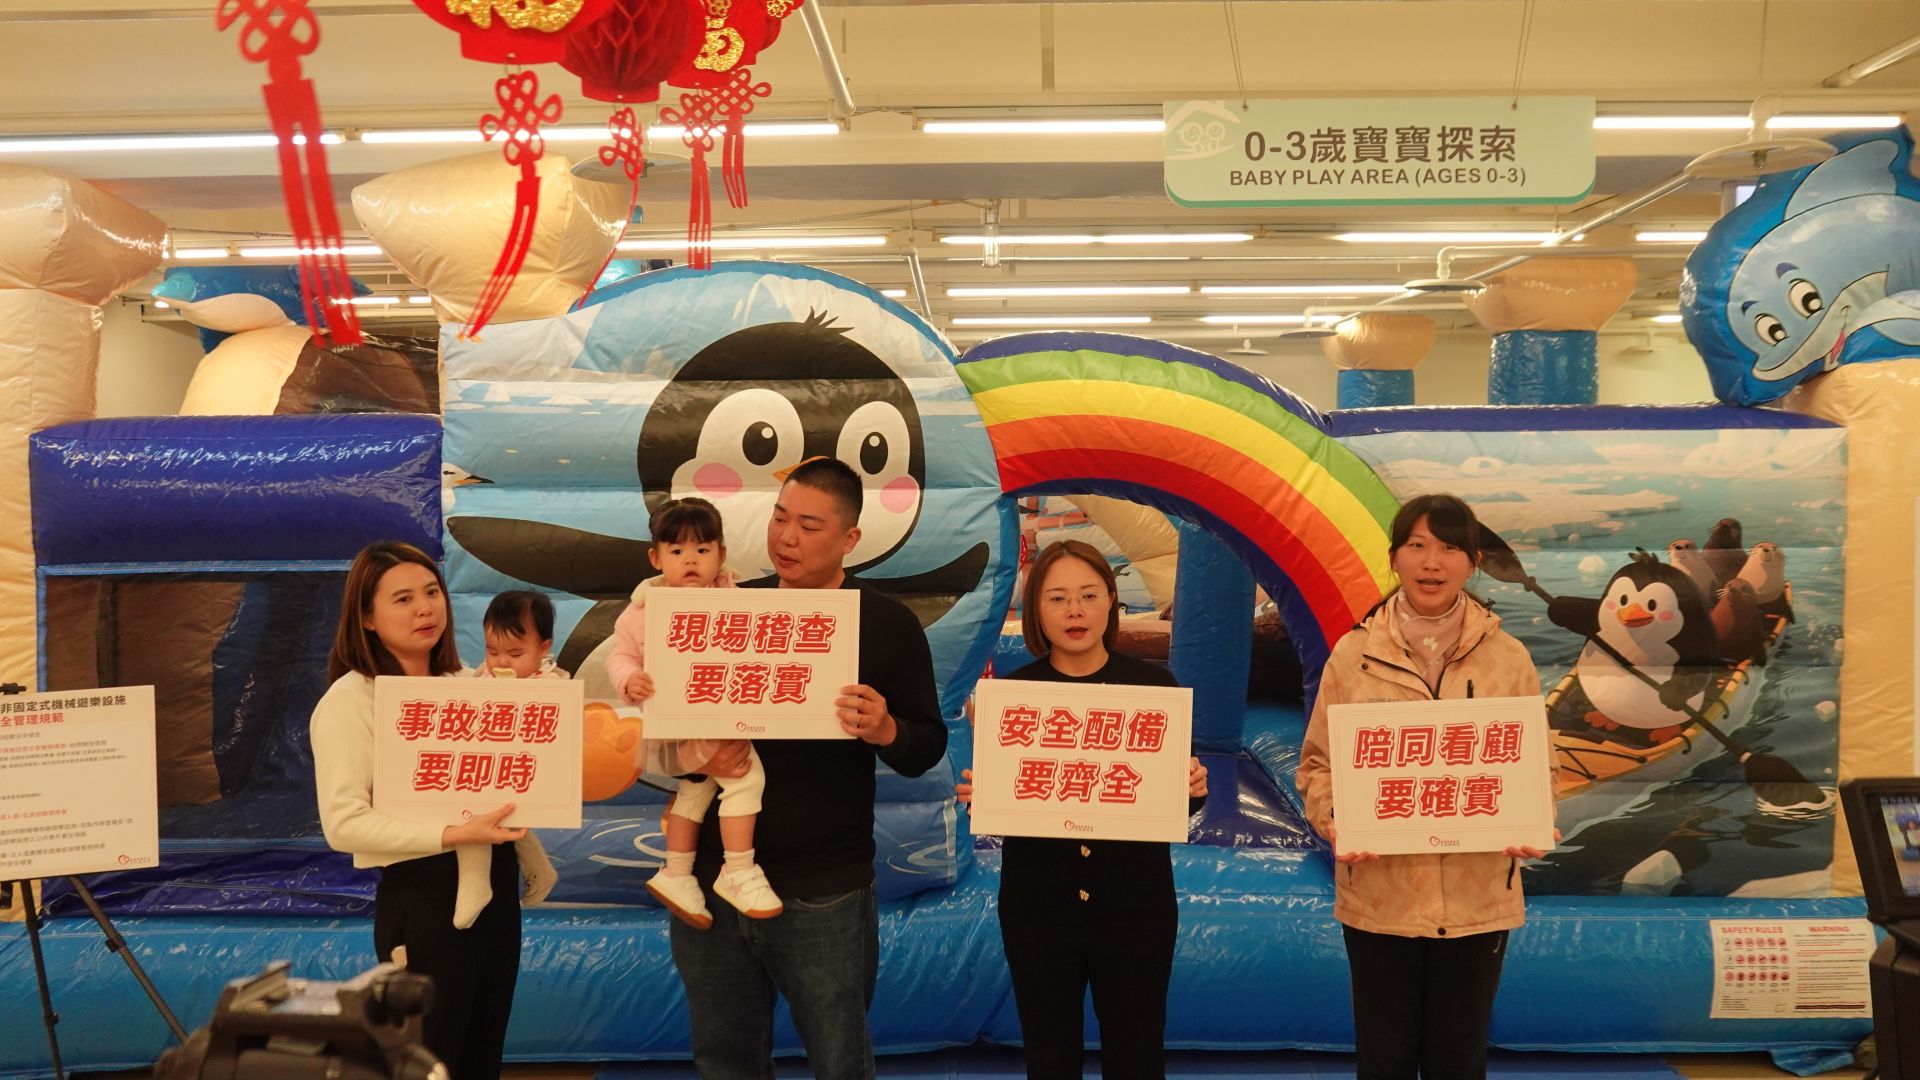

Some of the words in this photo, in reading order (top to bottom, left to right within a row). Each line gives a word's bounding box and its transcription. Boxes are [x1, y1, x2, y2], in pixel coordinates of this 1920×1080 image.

[1244, 125, 1517, 164] 0-3歲寶寶探索
[1229, 169, 1287, 187] BABY
[1292, 169, 1347, 186] PLAY
[1350, 168, 1410, 186] AREA
[1414, 168, 1482, 188] (AGES
[1486, 167, 1527, 187] 0-3)
[667, 611, 837, 653] 現場稽查
[0, 695, 126, 713] 非固定式機械遊樂設施
[686, 661, 813, 704] 要落實
[0, 712, 64, 727] 全管理規範
[396, 699, 560, 743] 事故通報
[999, 704, 1168, 753] 安全配備
[1353, 720, 1524, 769] 陪同看顧
[413, 751, 538, 794] 要即時
[1014, 757, 1143, 804] 要齊全
[1375, 773, 1503, 820] 要確實
